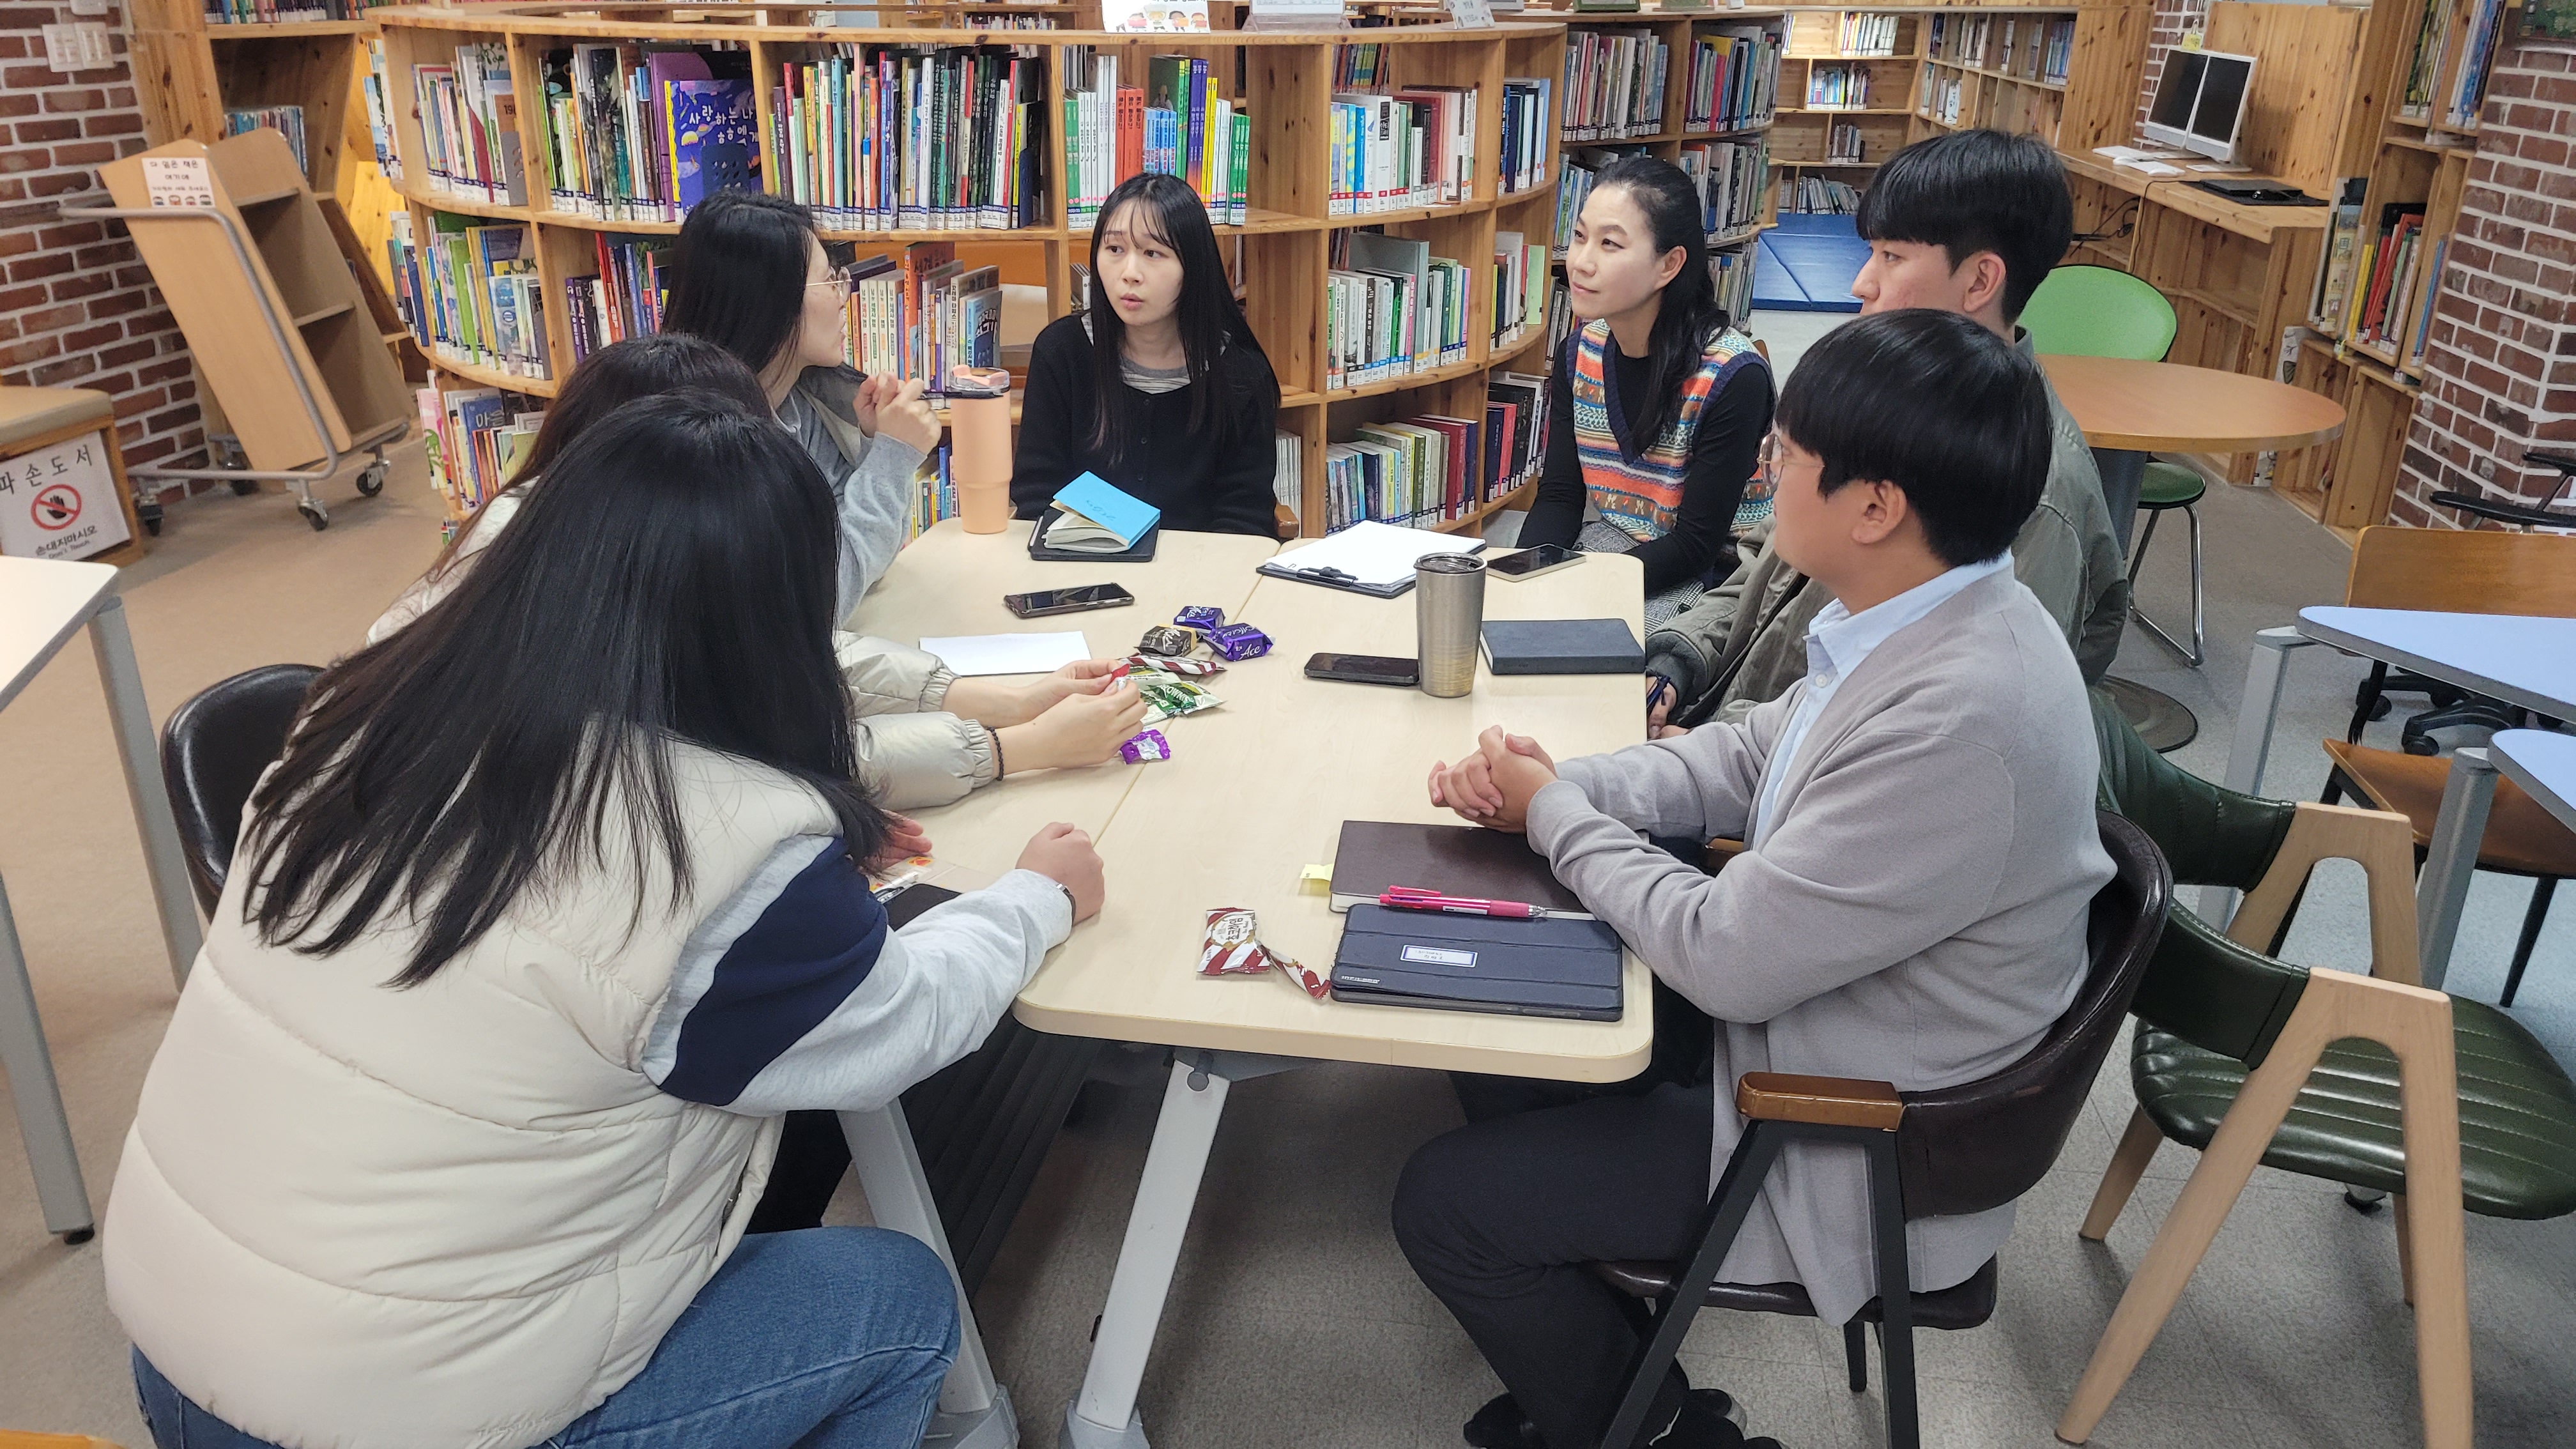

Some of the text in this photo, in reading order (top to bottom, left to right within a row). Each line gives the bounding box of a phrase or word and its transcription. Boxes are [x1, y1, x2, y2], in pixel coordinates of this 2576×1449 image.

[689, 104, 756, 125] 사랑하는 나
[0, 444, 92, 495] 파손도서
[35, 525, 98, 556] 손대지마시오
[48, 540, 91, 559] Don't Touch
[1239, 643, 1262, 660] Ace
[1225, 917, 1243, 940] 초코하임
